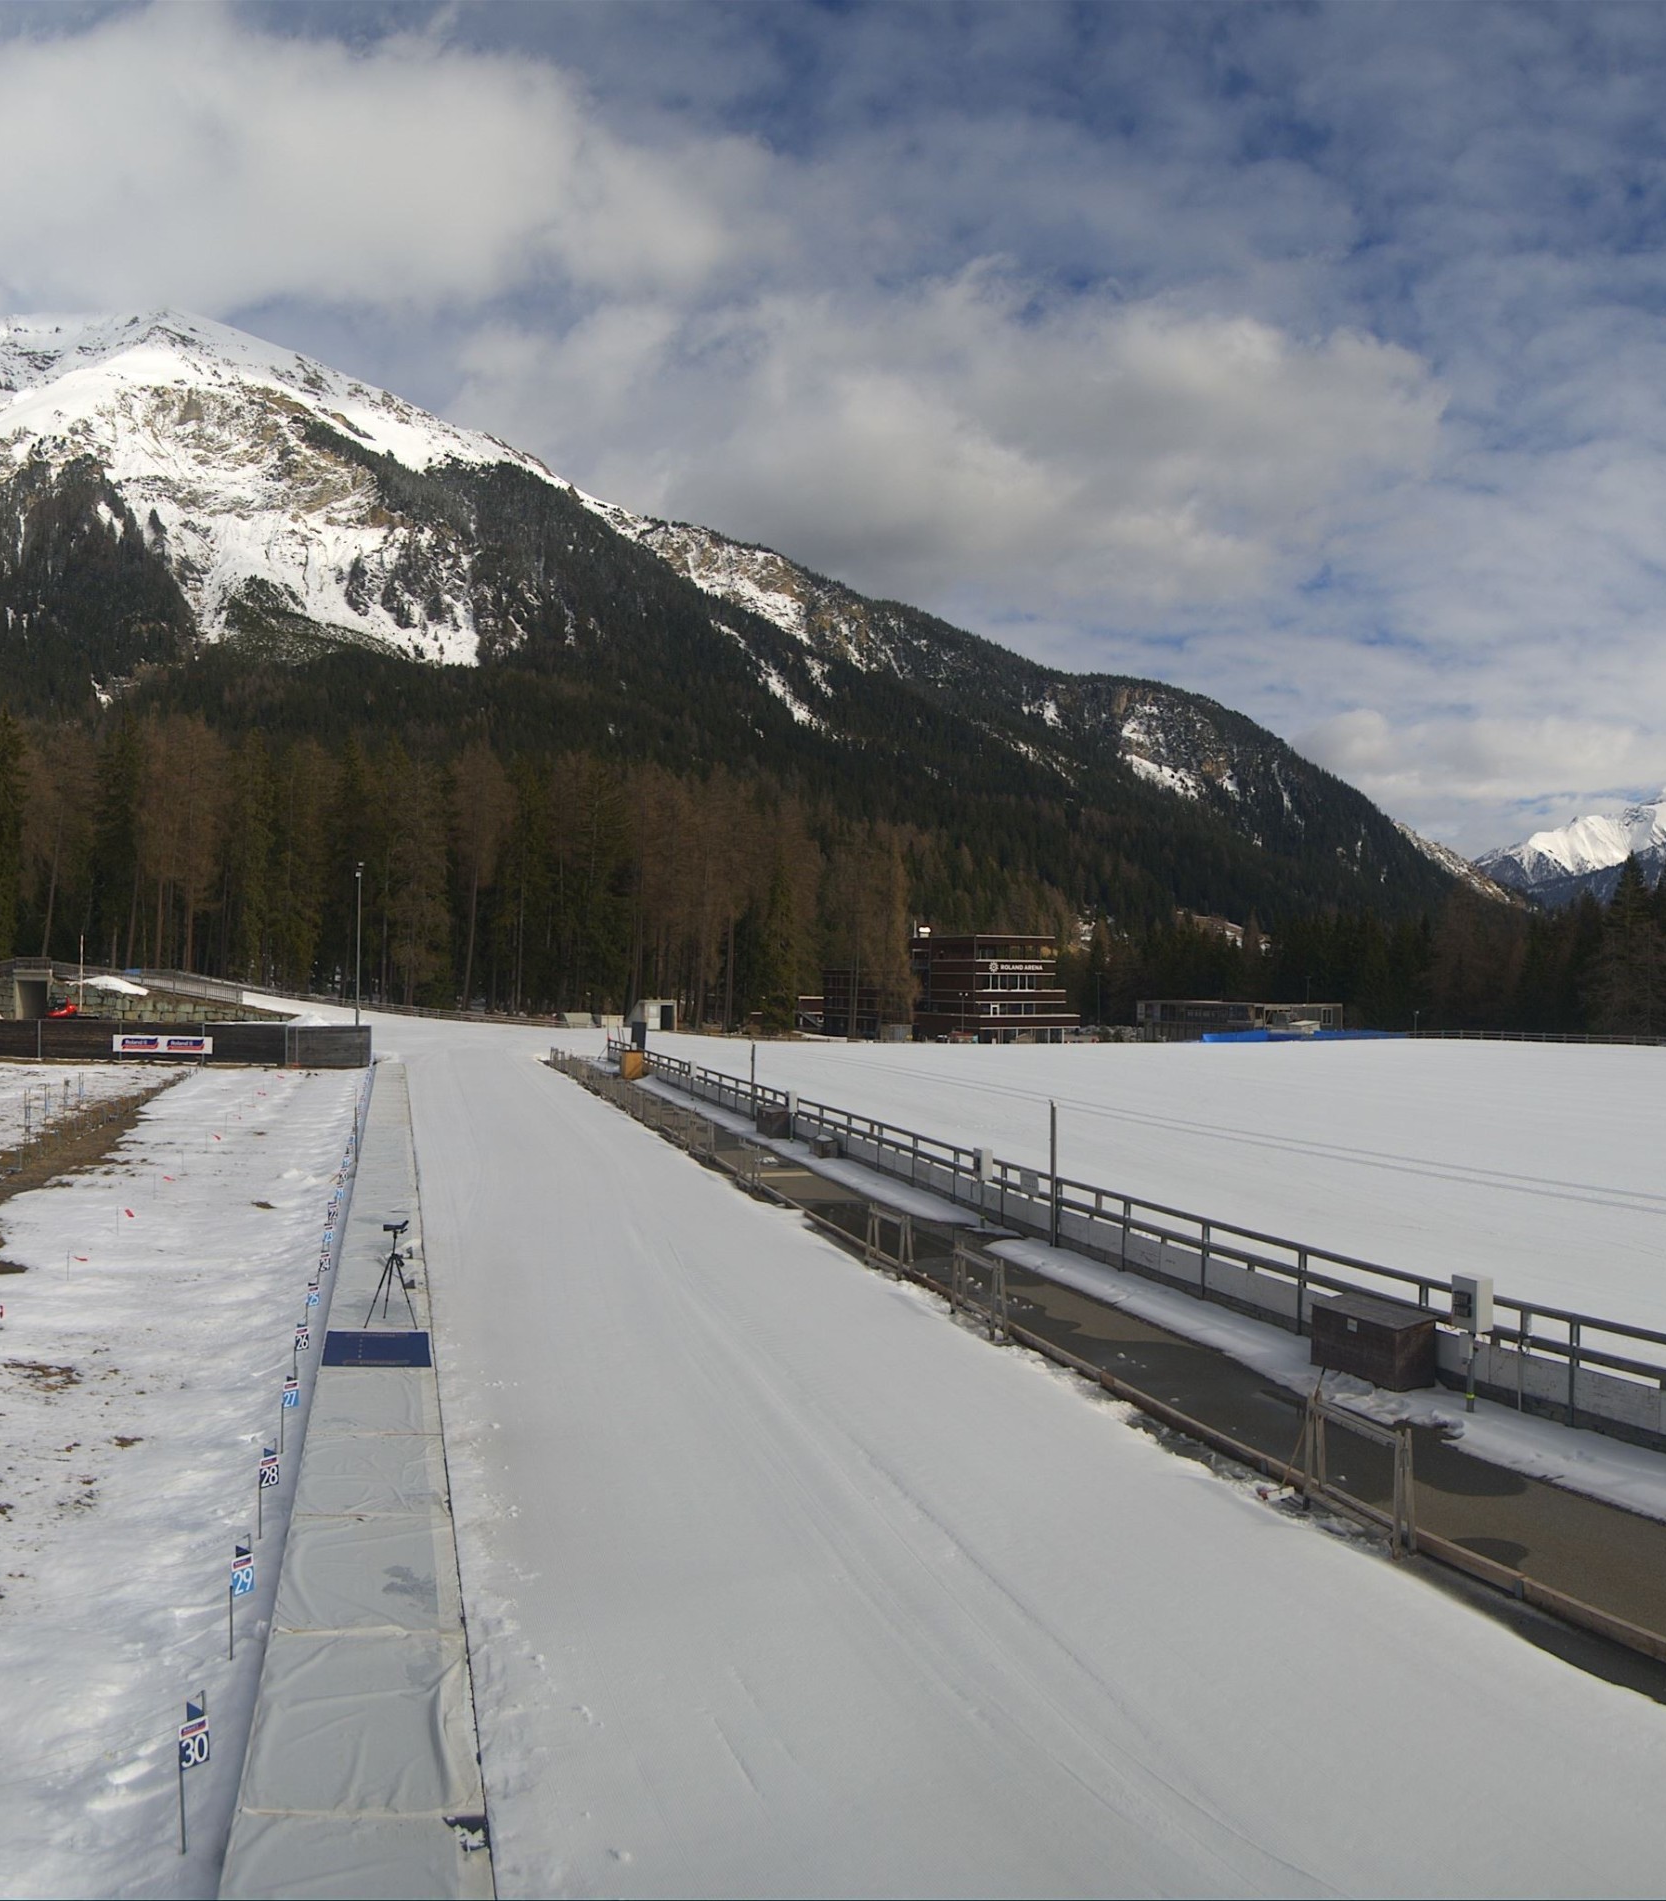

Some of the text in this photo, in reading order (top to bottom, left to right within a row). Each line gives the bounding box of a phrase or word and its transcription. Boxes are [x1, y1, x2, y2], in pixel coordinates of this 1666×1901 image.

[308, 1293, 319, 1306] 25
[296, 1335, 309, 1350] 26
[283, 1390, 297, 1408] 27
[260, 1465, 278, 1488] 28
[234, 1567, 253, 1596] 29
[181, 1732, 208, 1768] 30
